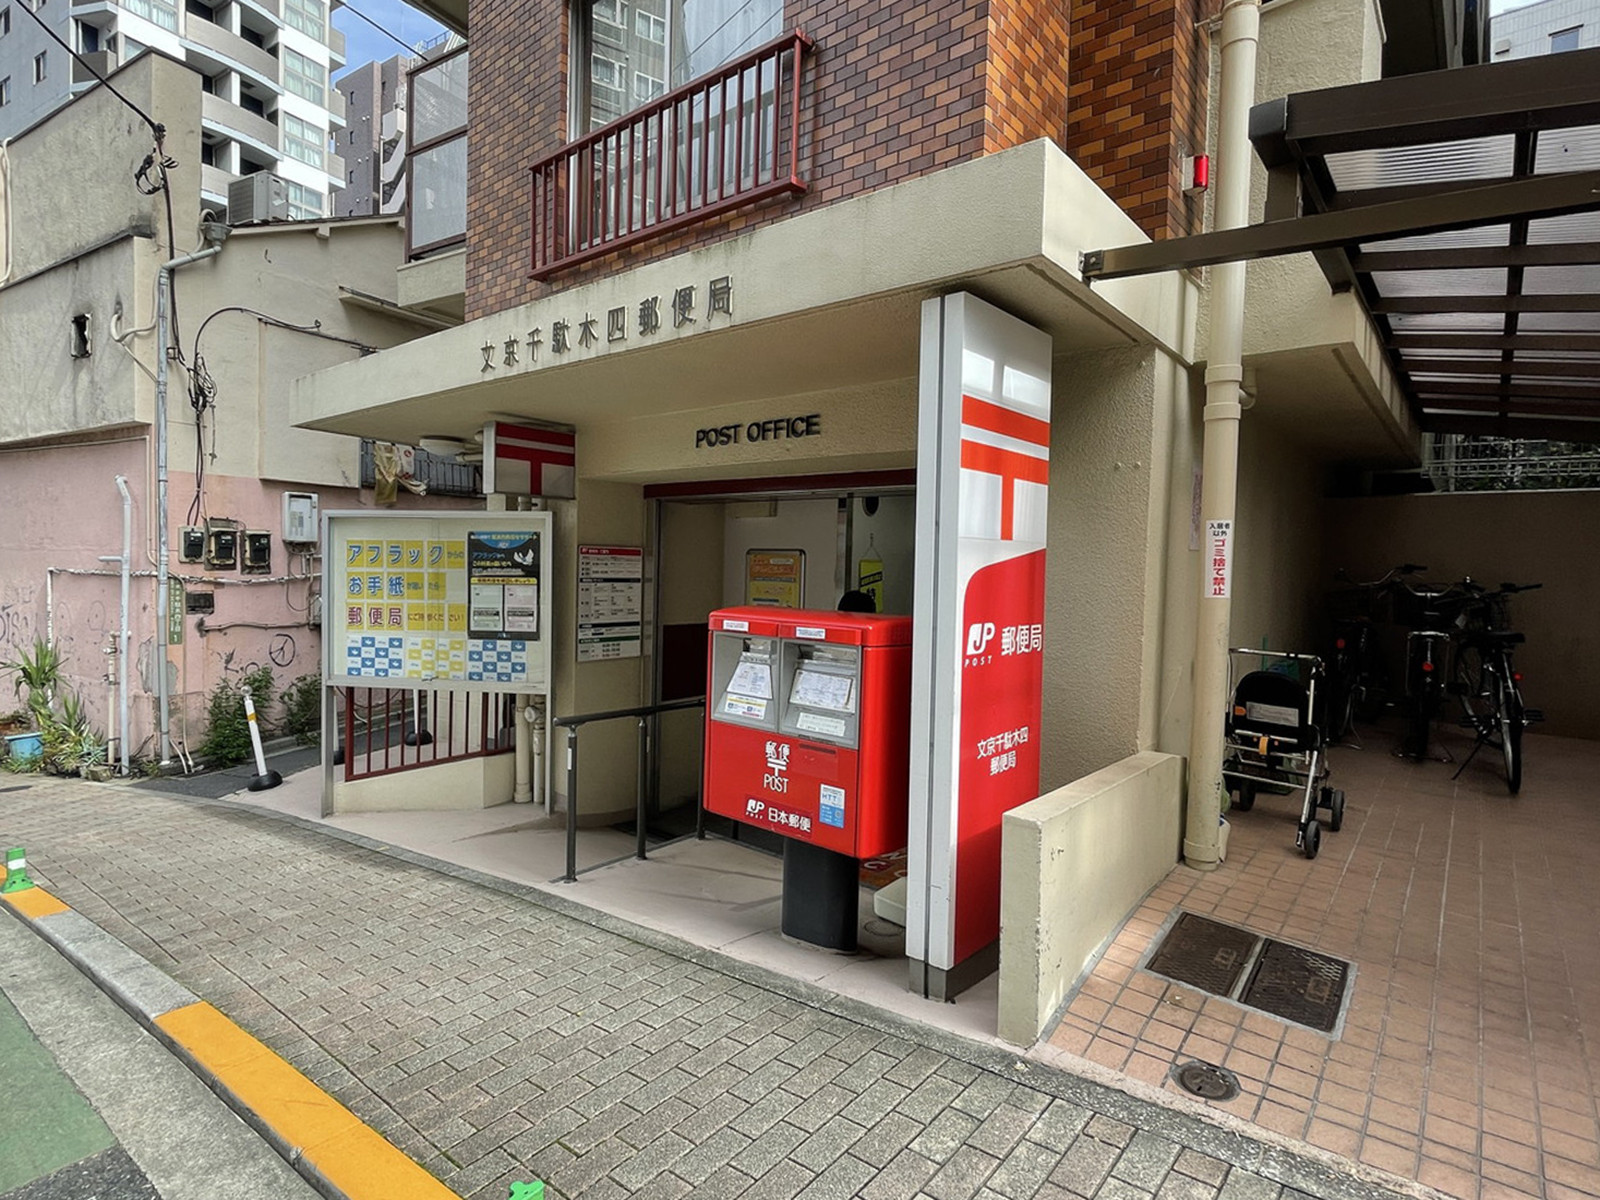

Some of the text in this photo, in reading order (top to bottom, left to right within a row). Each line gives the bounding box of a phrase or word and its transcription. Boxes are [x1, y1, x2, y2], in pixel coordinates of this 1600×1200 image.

[696, 414, 821, 448] POST OFFICE
[1212, 538, 1226, 596] ゴミ捨て禁止
[1001, 624, 1043, 656] 郵便局
[964, 656, 992, 667] POST
[765, 740, 790, 763] 郵便
[990, 750, 1016, 776] 郵便局
[763, 774, 789, 793] POST
[768, 807, 811, 832] 日本郵便
